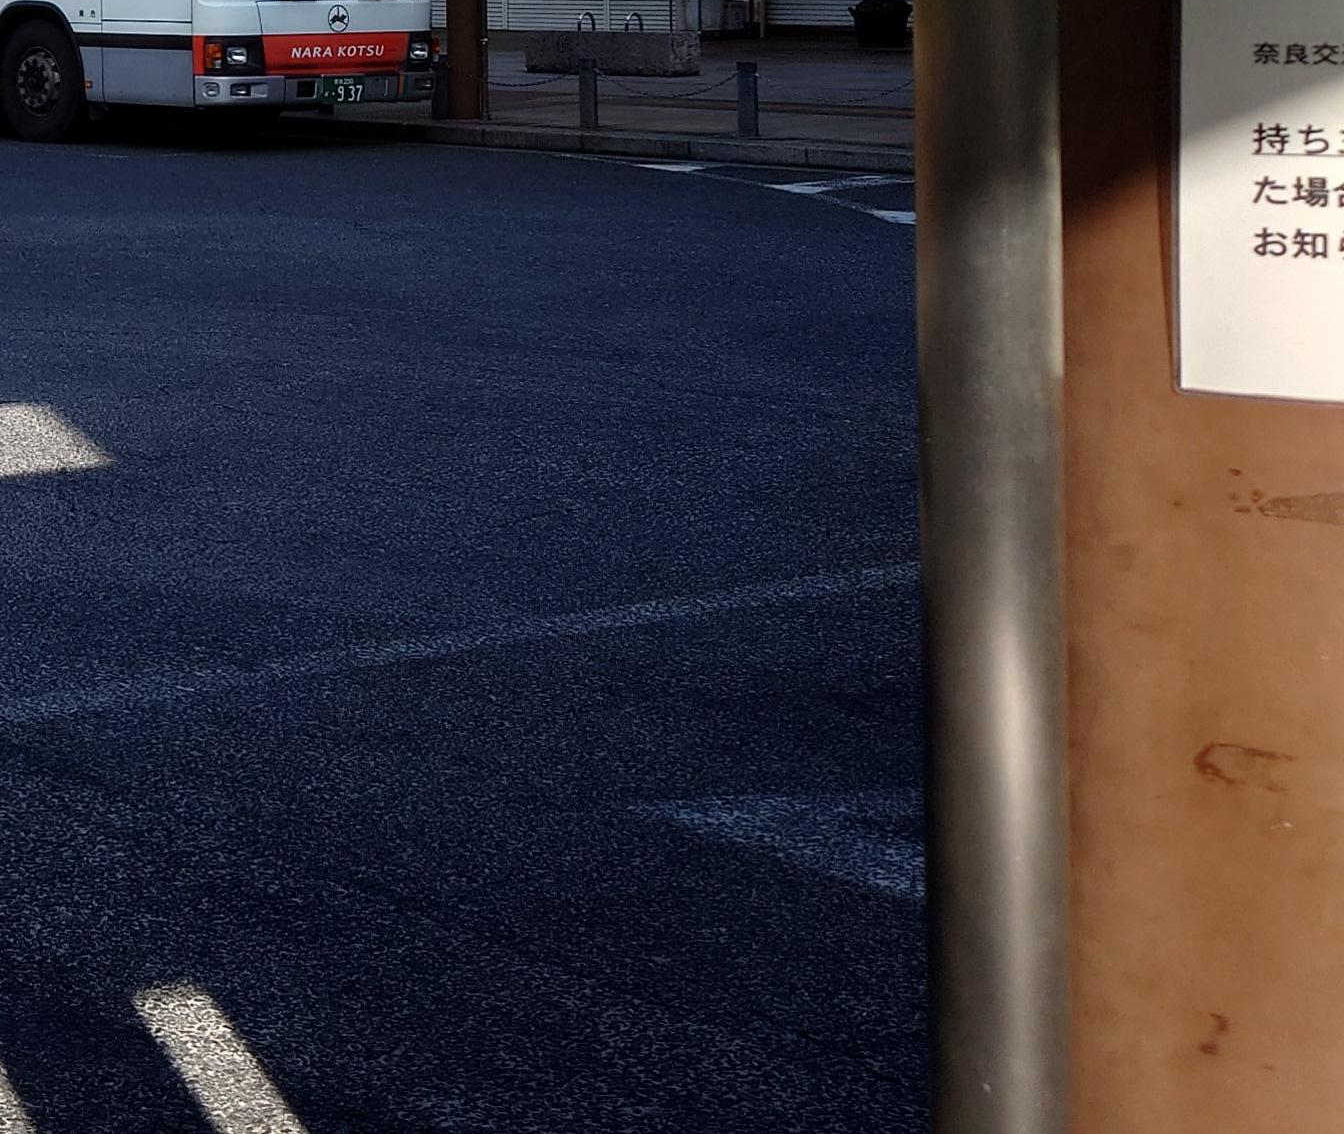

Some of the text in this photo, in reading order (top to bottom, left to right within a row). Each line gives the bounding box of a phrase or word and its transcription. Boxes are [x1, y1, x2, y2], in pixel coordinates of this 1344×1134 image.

[291, 44, 385, 59] NARA KOTSU
[1253, 42, 1344, 65] 奈良交
[1252, 122, 1344, 155] 持ち
[1253, 227, 1344, 259] お知
